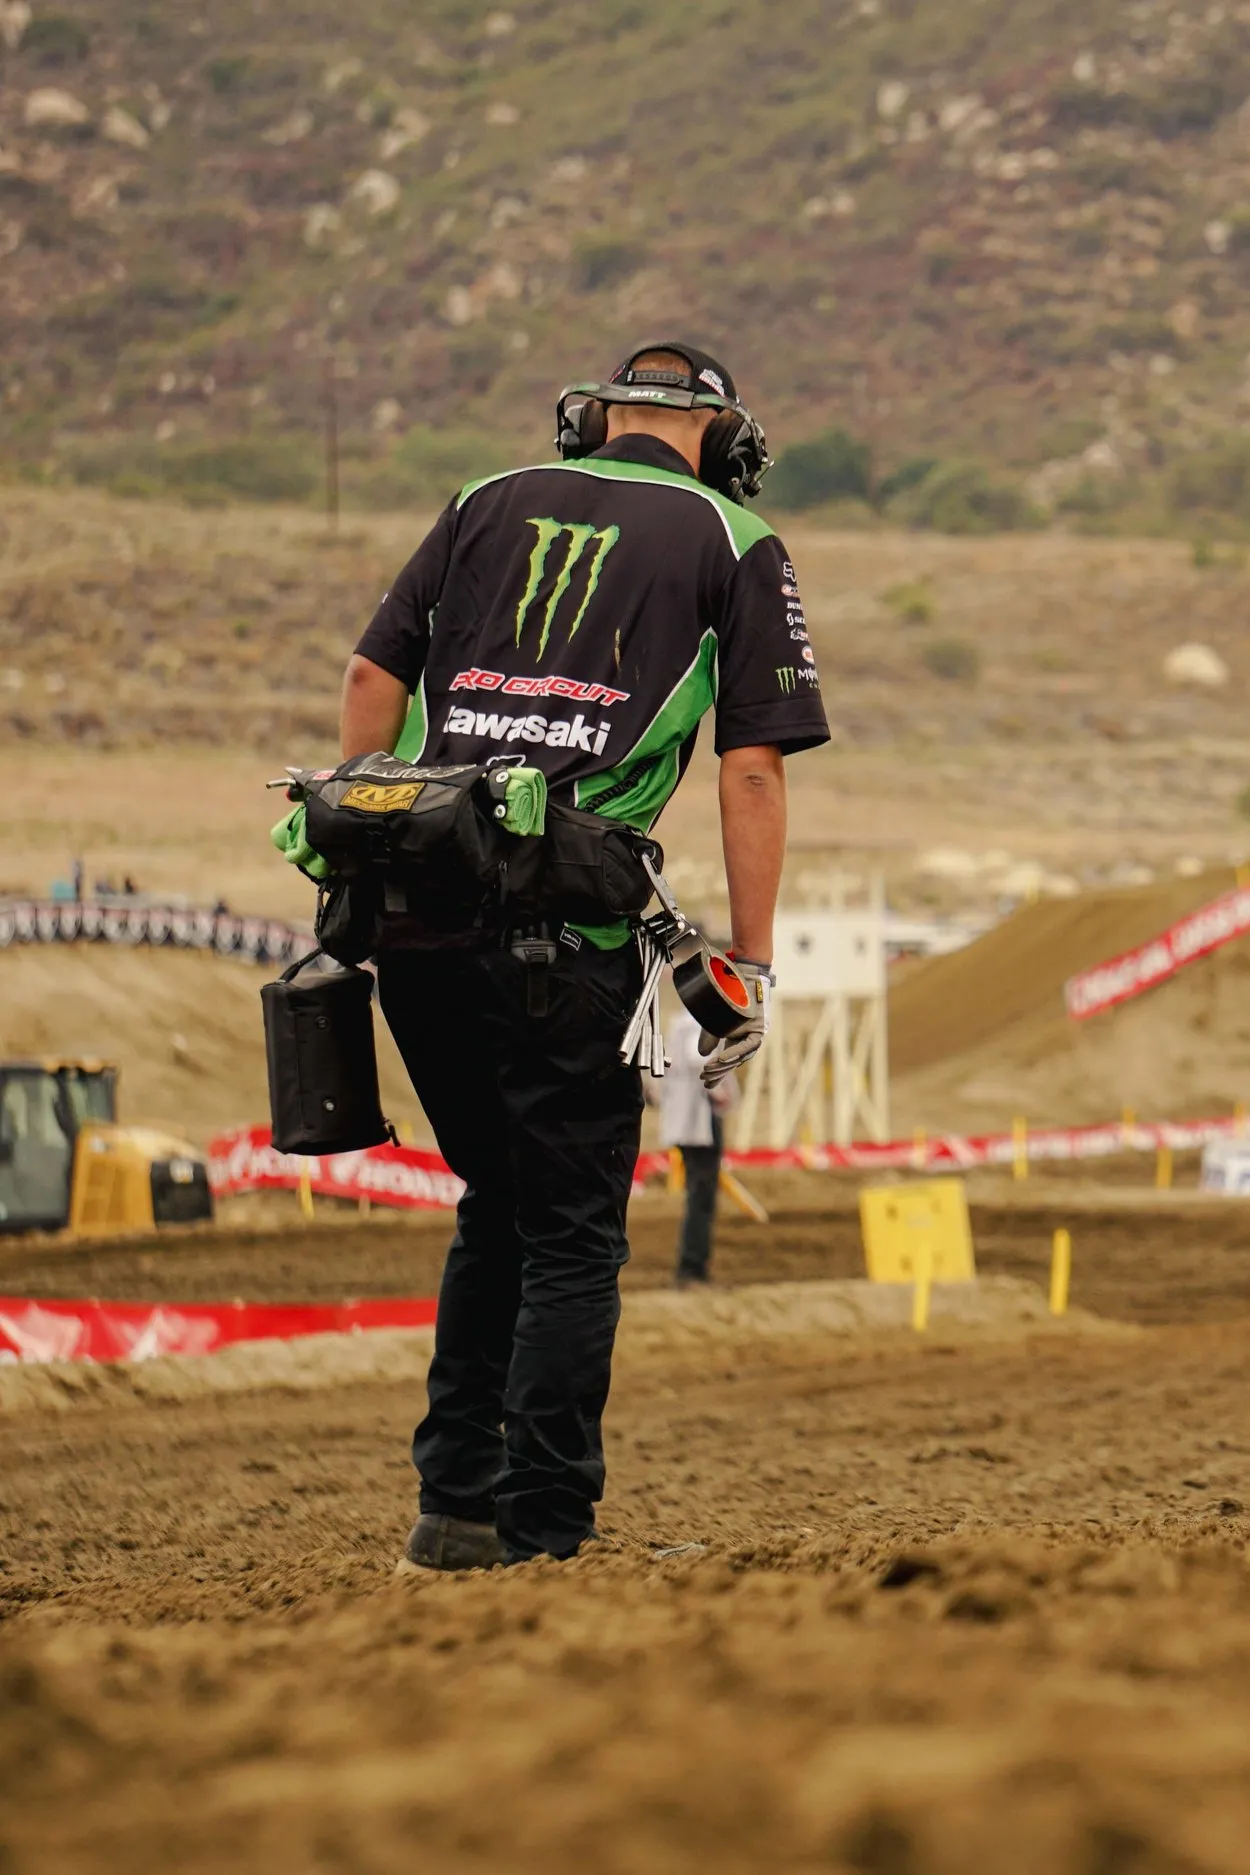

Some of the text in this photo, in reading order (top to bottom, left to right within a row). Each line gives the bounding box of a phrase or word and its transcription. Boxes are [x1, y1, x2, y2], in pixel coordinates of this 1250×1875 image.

[628, 390, 667, 399] MATT
[502, 675, 631, 707] CIRCUIT
[443, 705, 612, 757] awasaki
